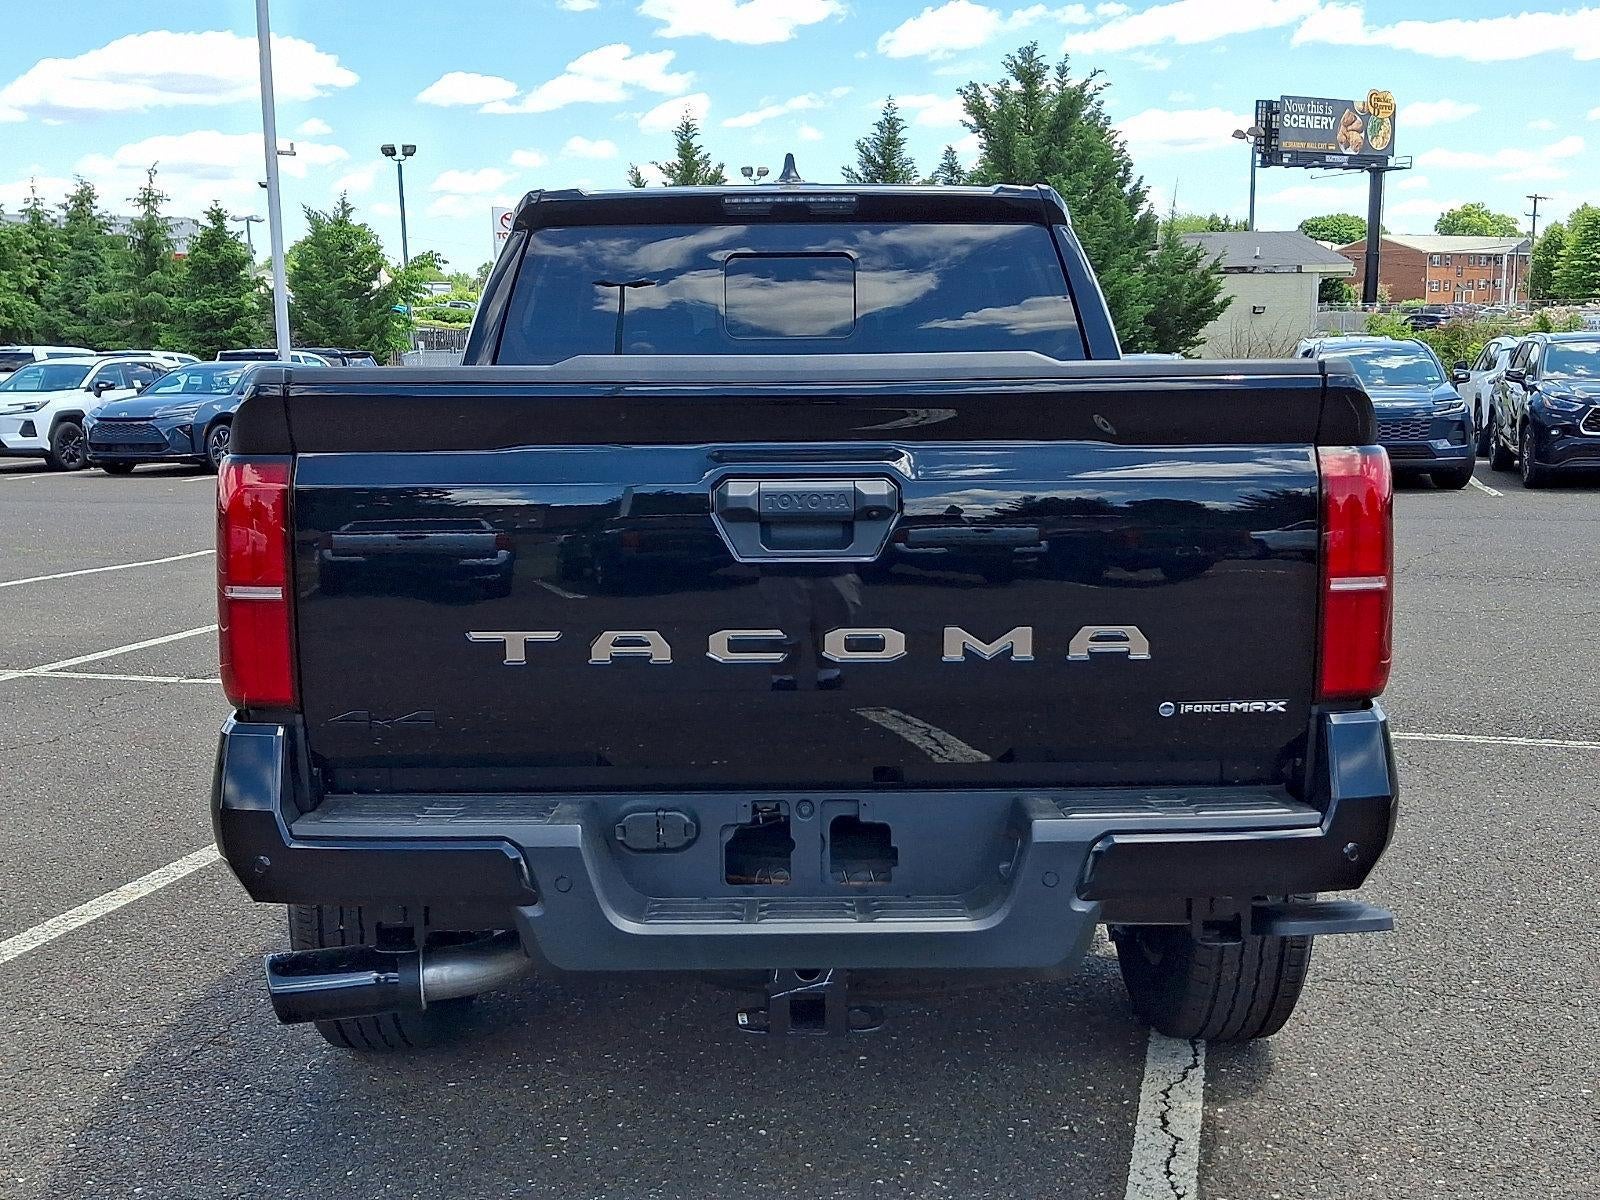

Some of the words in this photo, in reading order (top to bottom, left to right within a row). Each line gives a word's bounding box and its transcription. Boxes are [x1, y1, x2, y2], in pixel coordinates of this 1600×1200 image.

[1284, 99, 1306, 113] Now
[1307, 101, 1324, 114] this
[1325, 102, 1333, 115] is
[1283, 113, 1336, 130] SCENERY
[764, 493, 850, 509] TOYOTA
[465, 625, 1152, 665] TACOMA
